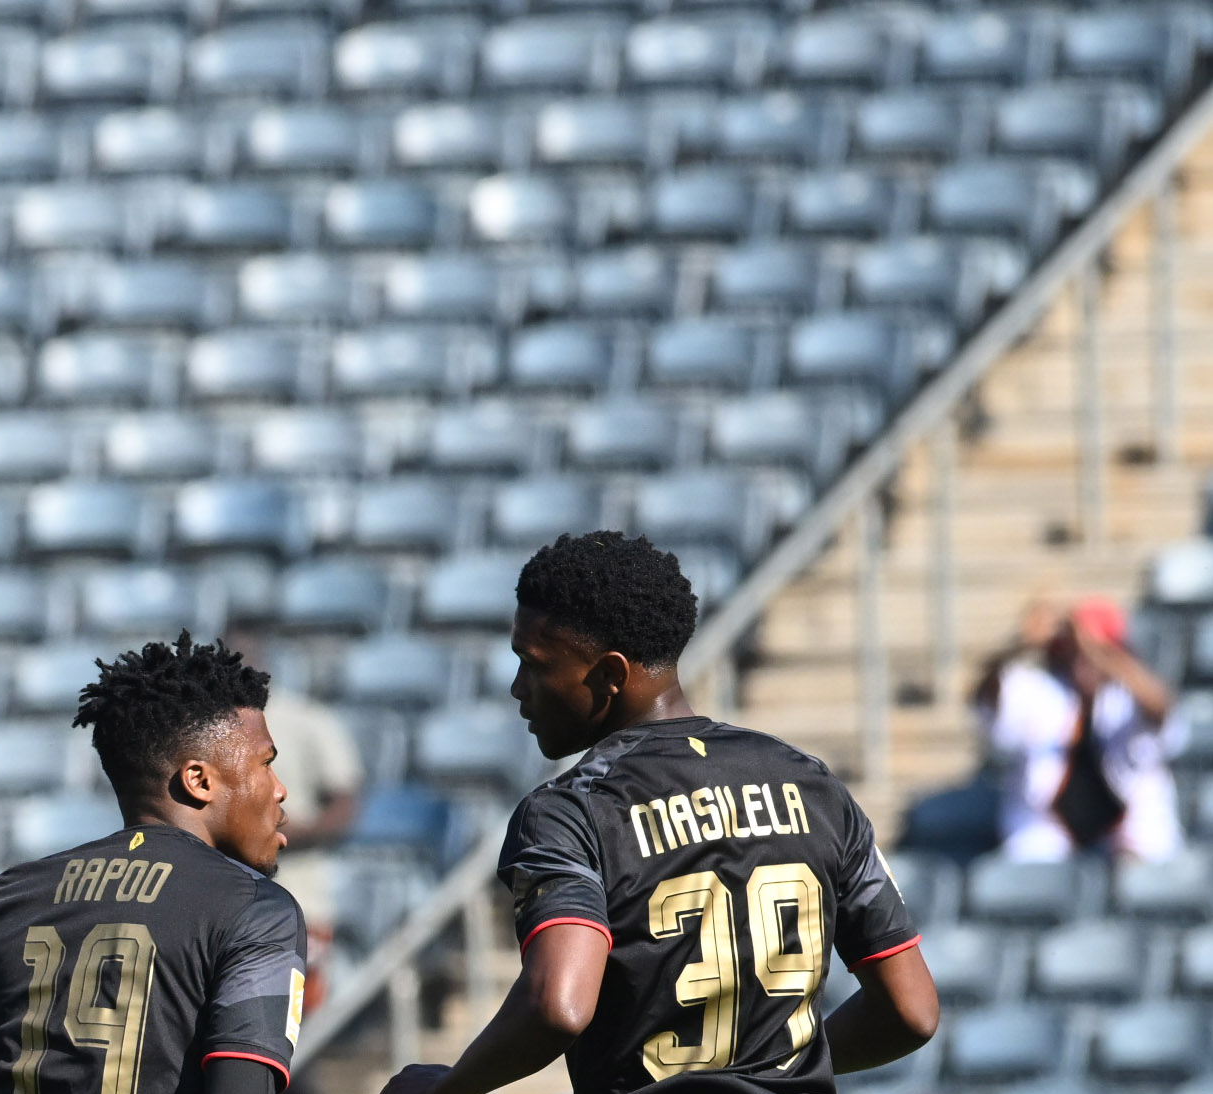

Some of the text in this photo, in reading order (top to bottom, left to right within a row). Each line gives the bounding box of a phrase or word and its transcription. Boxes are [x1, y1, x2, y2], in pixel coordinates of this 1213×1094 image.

[630, 783, 810, 857] MASILELA
[53, 857, 173, 904] RAPOO
[642, 863, 825, 1082] 39
